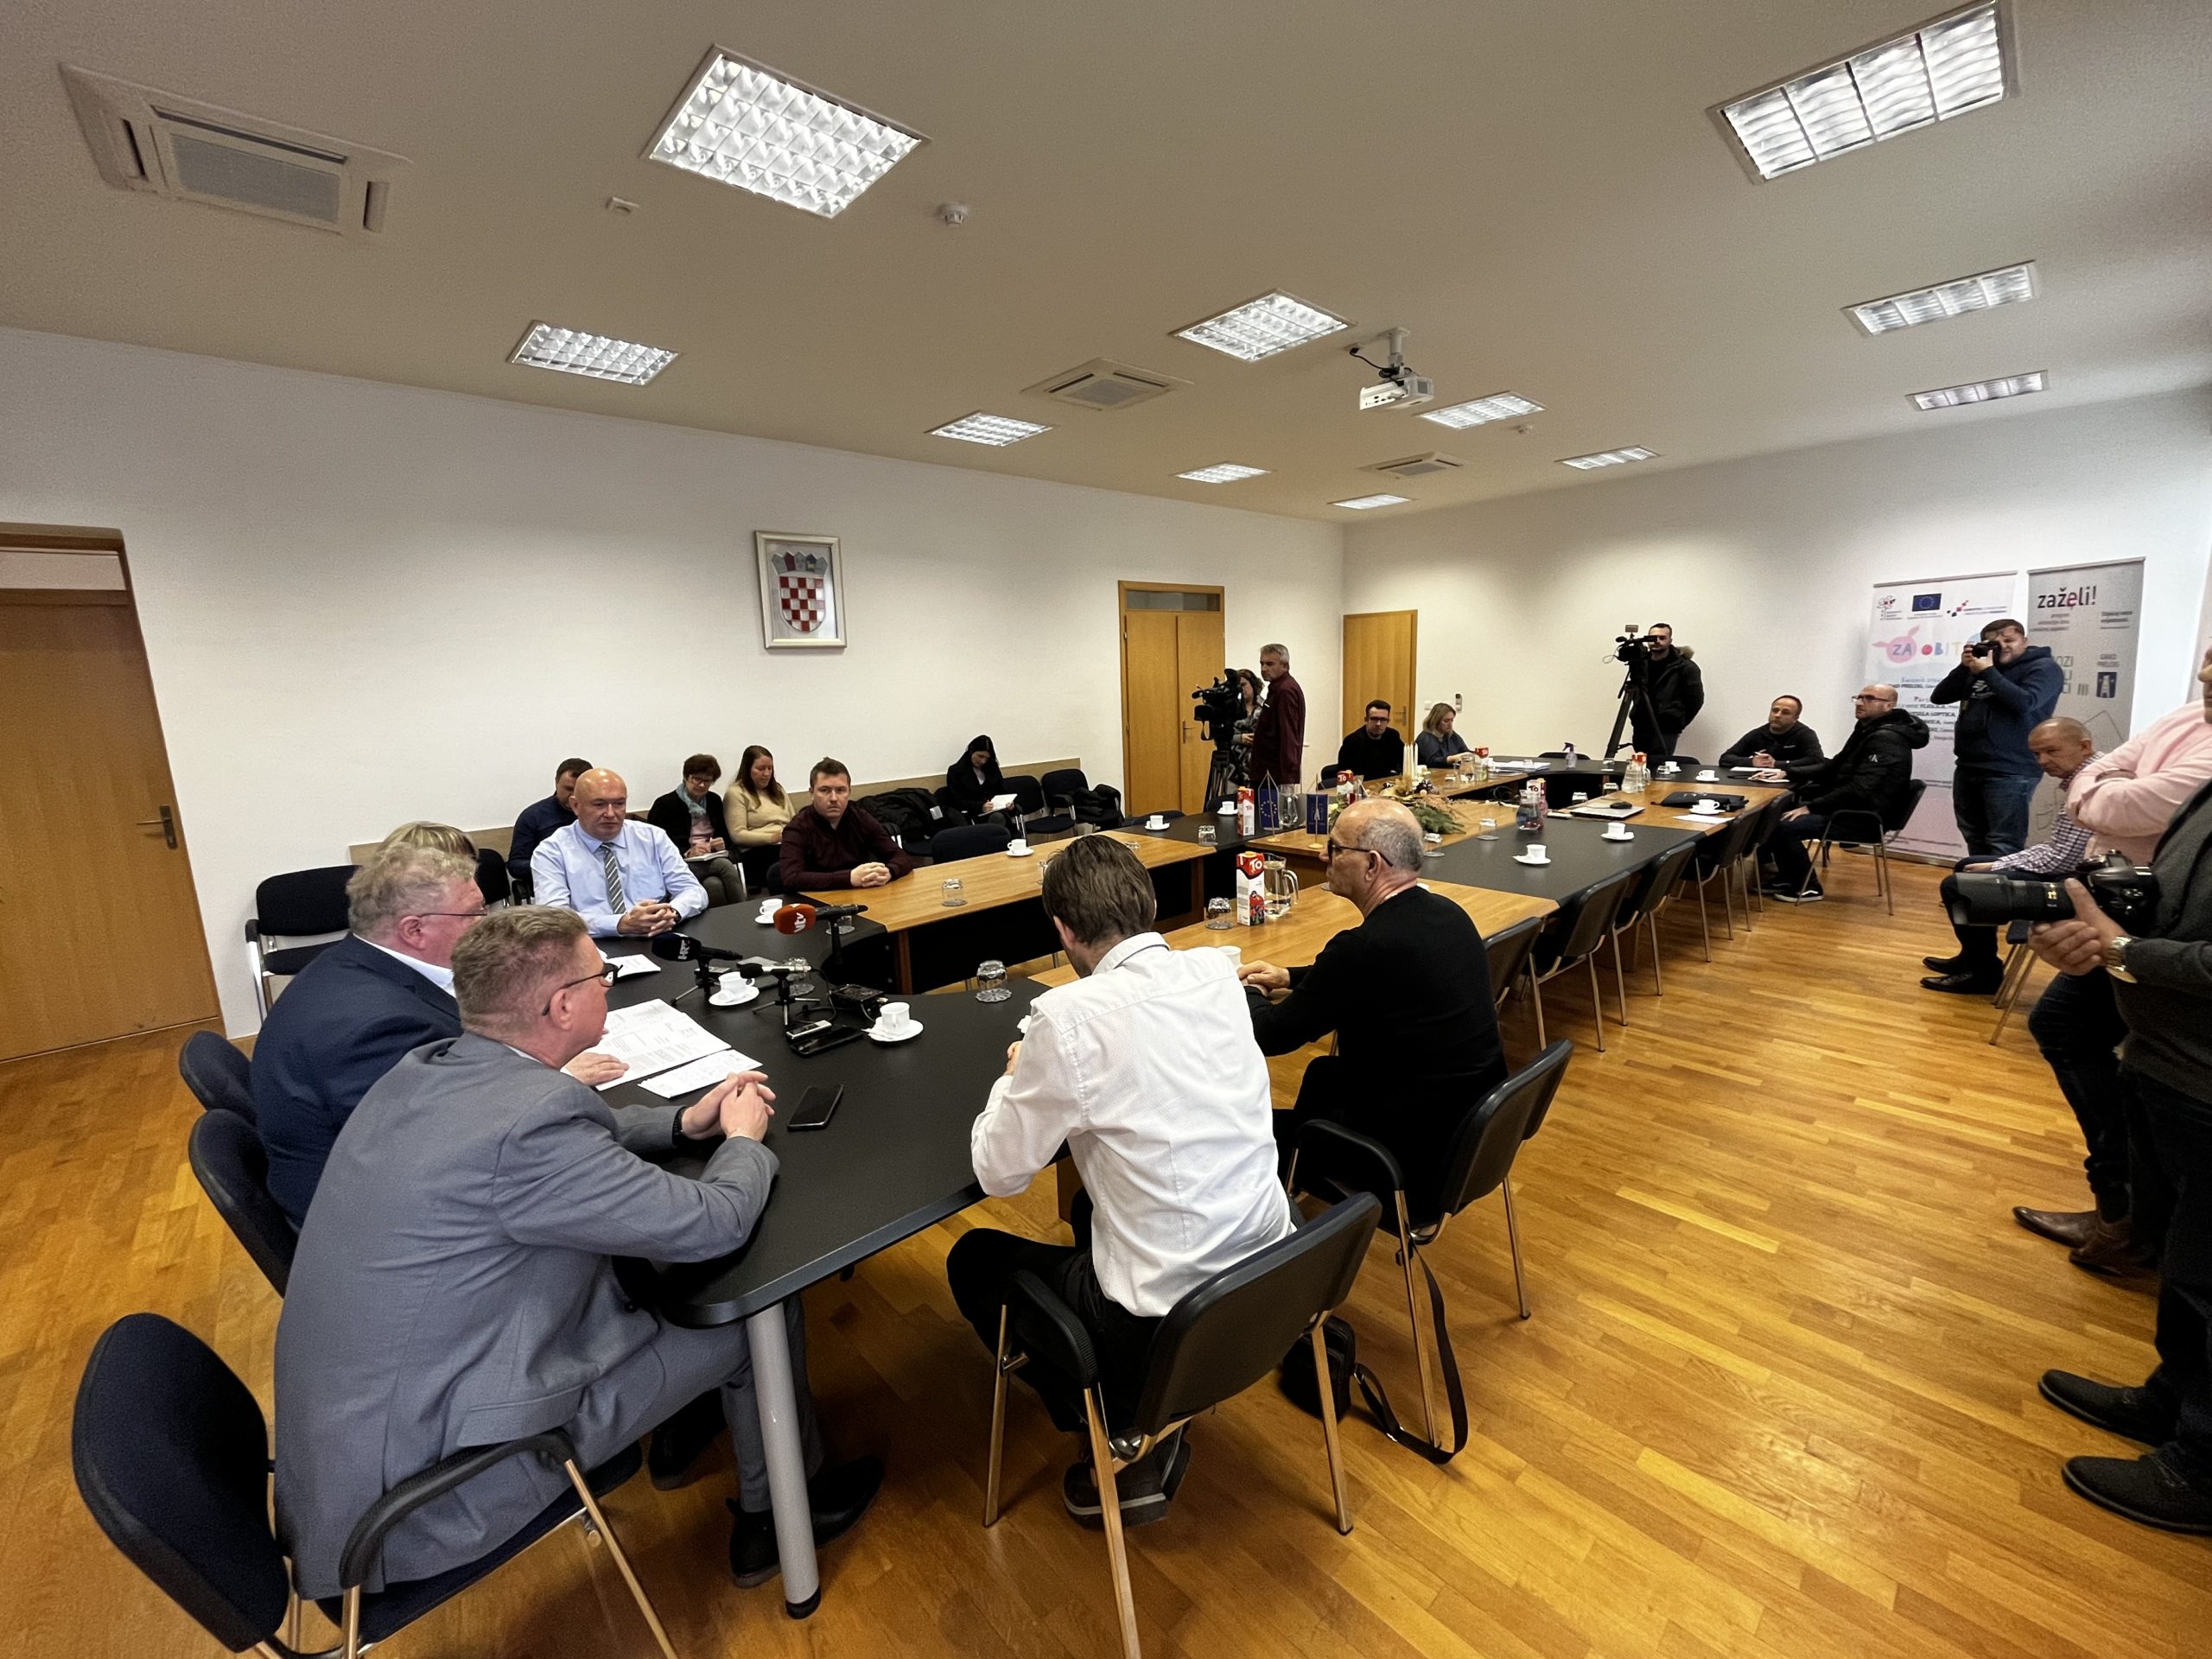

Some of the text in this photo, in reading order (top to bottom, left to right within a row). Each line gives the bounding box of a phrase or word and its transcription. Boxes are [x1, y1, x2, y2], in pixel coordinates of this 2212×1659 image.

[2037, 586, 2097, 609] zaželi!
[1892, 641, 1964, 657] ZA OBIT
[793, 912, 807, 933] vtv
